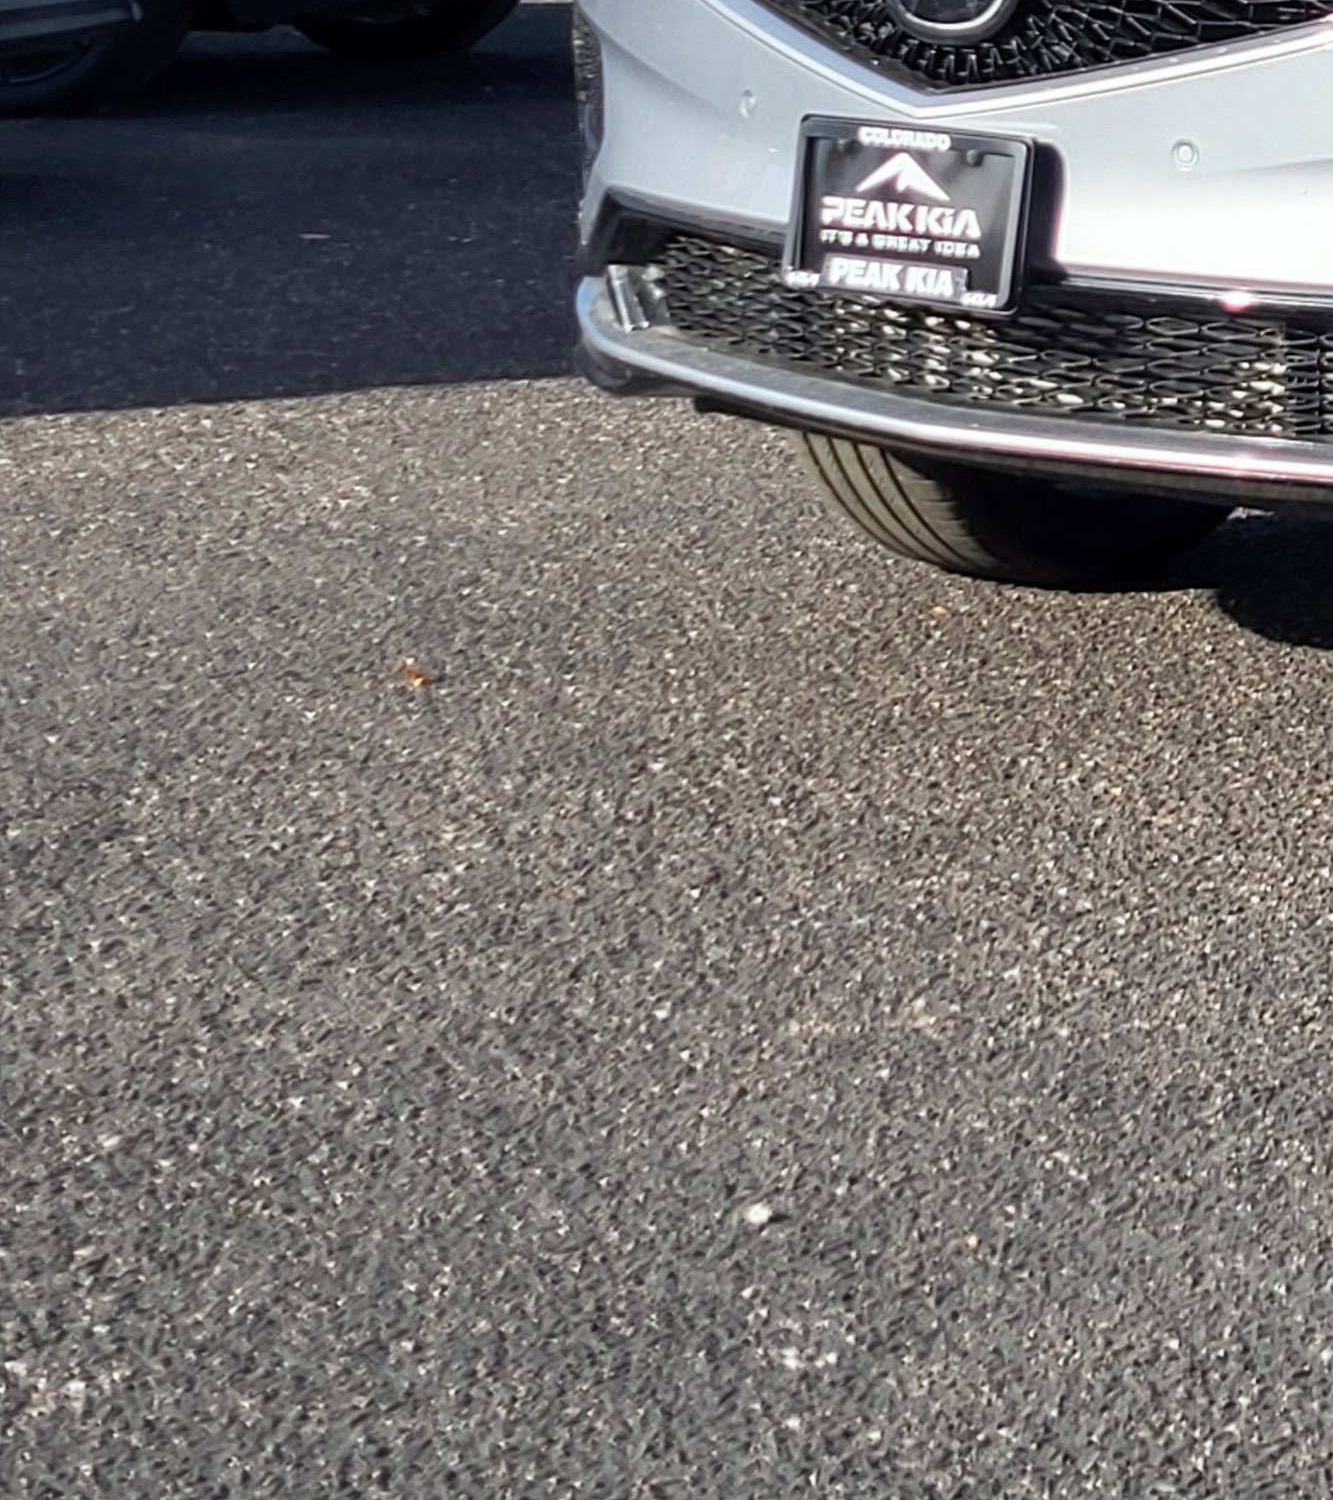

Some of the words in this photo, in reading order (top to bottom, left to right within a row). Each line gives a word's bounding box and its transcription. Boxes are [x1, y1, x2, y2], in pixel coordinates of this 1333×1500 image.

[858, 126, 951, 151] COLORADO
[820, 195, 914, 233] PEAK
[915, 205, 982, 240] KIA
[855, 233, 869, 247] A
[871, 233, 931, 253] GREAT
[934, 241, 981, 258] IDEA
[828, 256, 904, 291] PEAK
[904, 266, 955, 298] KIA
